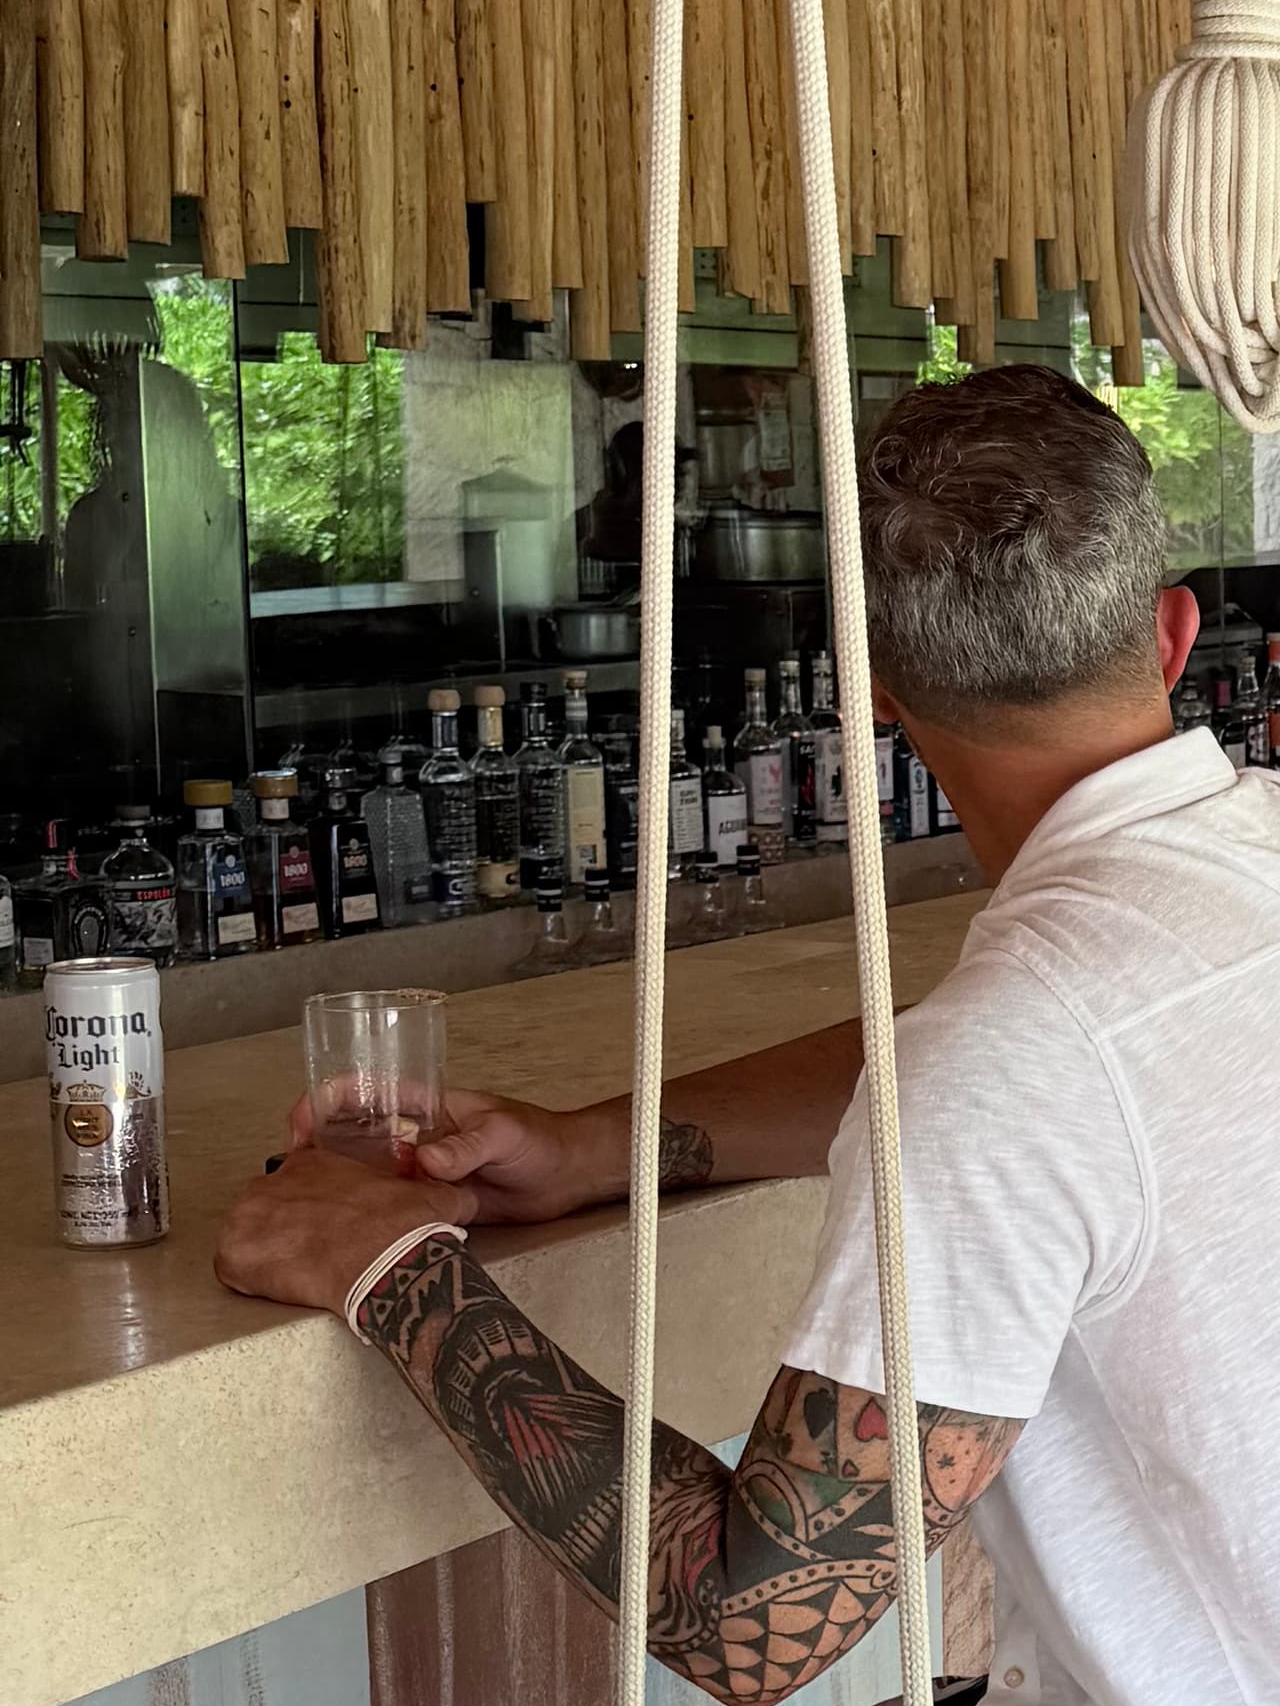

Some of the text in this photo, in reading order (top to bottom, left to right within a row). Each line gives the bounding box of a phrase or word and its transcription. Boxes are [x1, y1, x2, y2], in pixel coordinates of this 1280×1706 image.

[344, 854, 368, 869] 1800
[284, 863, 308, 877] 1800
[220, 871, 245, 887] 1800
[46, 1006, 147, 1041] Corona
[53, 1043, 119, 1071] Light
